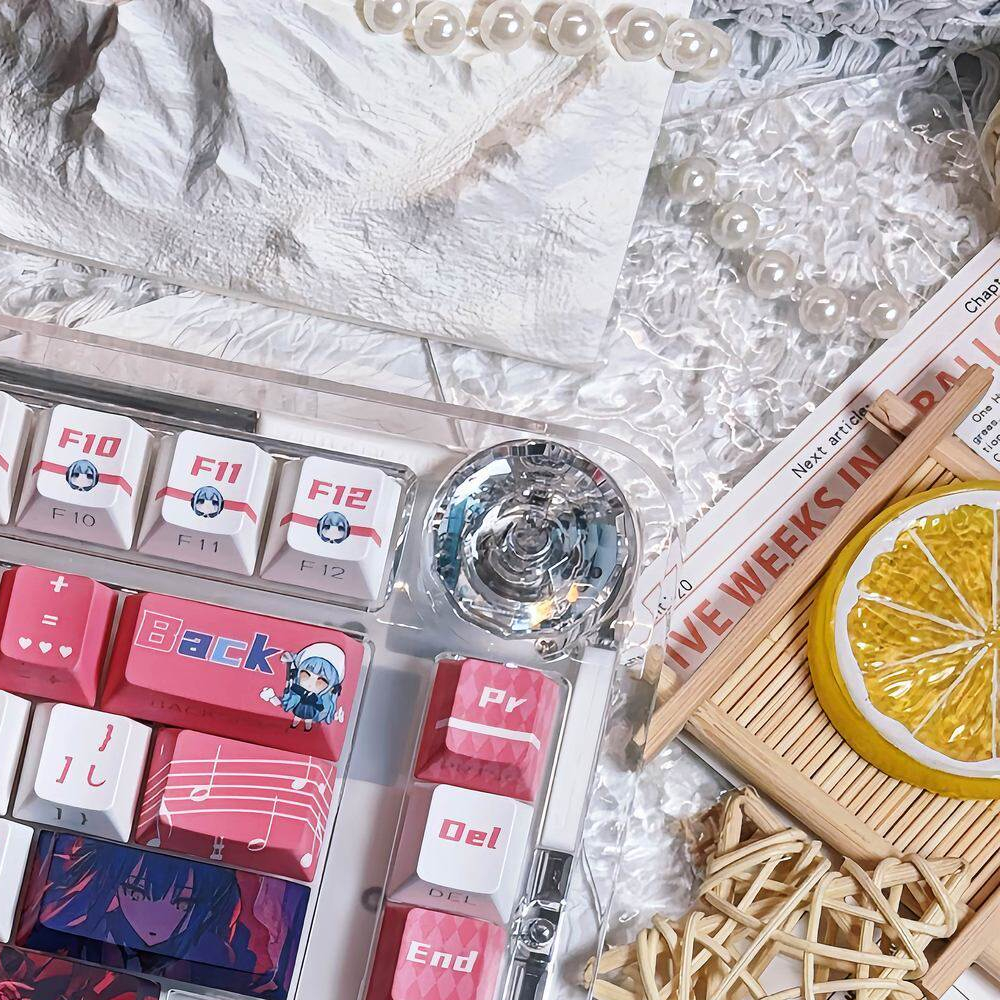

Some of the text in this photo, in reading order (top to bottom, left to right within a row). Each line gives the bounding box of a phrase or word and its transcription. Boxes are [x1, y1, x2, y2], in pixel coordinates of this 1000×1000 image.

[58, 428, 121, 458] F10
[191, 456, 242, 484] F11
[791, 446, 827, 479] Next
[308, 479, 372, 510] F12
[53, 508, 95, 527] F10
[719, 486, 844, 606] WEEKS
[836, 444, 884, 490] IN
[178, 534, 218, 553] F11
[300, 560, 345, 579] F12
[51, 576, 68, 592] +
[42, 615, 58, 625] =
[134, 608, 286, 675] Back
[479, 687, 527, 712] Pr
[87, 765, 106, 787] し
[439, 819, 501, 849] Del
[428, 888, 477, 906] DEL
[406, 941, 478, 972] End
